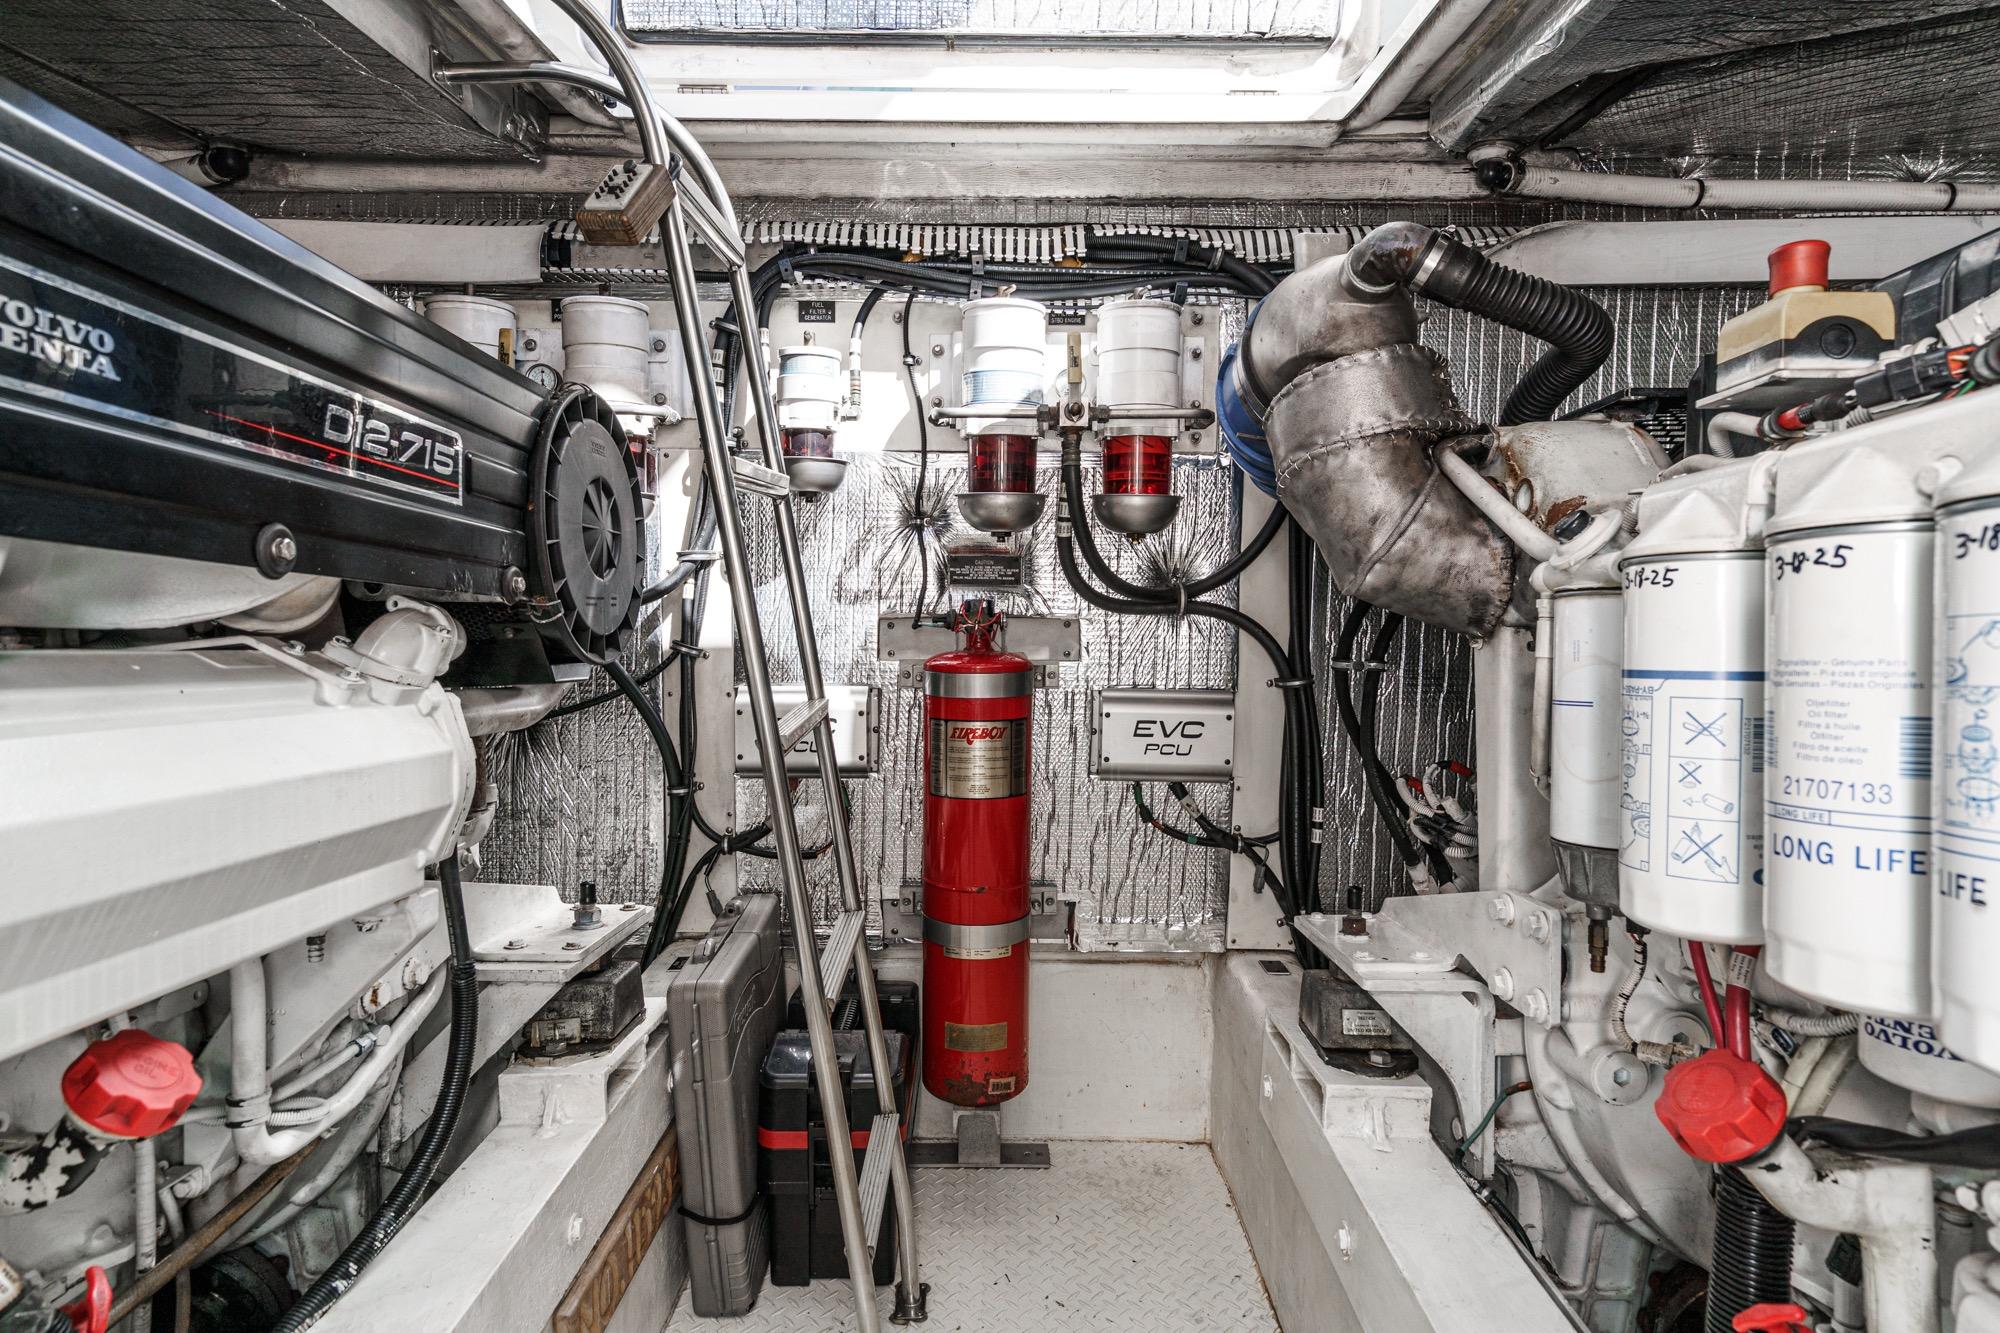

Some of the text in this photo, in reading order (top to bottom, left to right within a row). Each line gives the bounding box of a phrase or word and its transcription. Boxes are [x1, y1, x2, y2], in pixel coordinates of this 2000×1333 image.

[0, 321, 121, 382] ENTA
[323, 403, 455, 476] D12-715
[1823, 710, 1848, 719] filter
[1833, 722, 1861, 731] huile
[950, 726, 1008, 746] FIREBOY
[1133, 720, 1205, 738] EVC
[1144, 743, 1193, 756] PCU
[1783, 775, 1893, 805] 21707133
[1777, 807, 1826, 822] LONG LIFE
[1772, 832, 1834, 866] LONG
[1855, 845, 1928, 876] LIFE
[1938, 868, 1987, 907] LIFE
[1864, 1021, 1966, 1063] VOLVO
